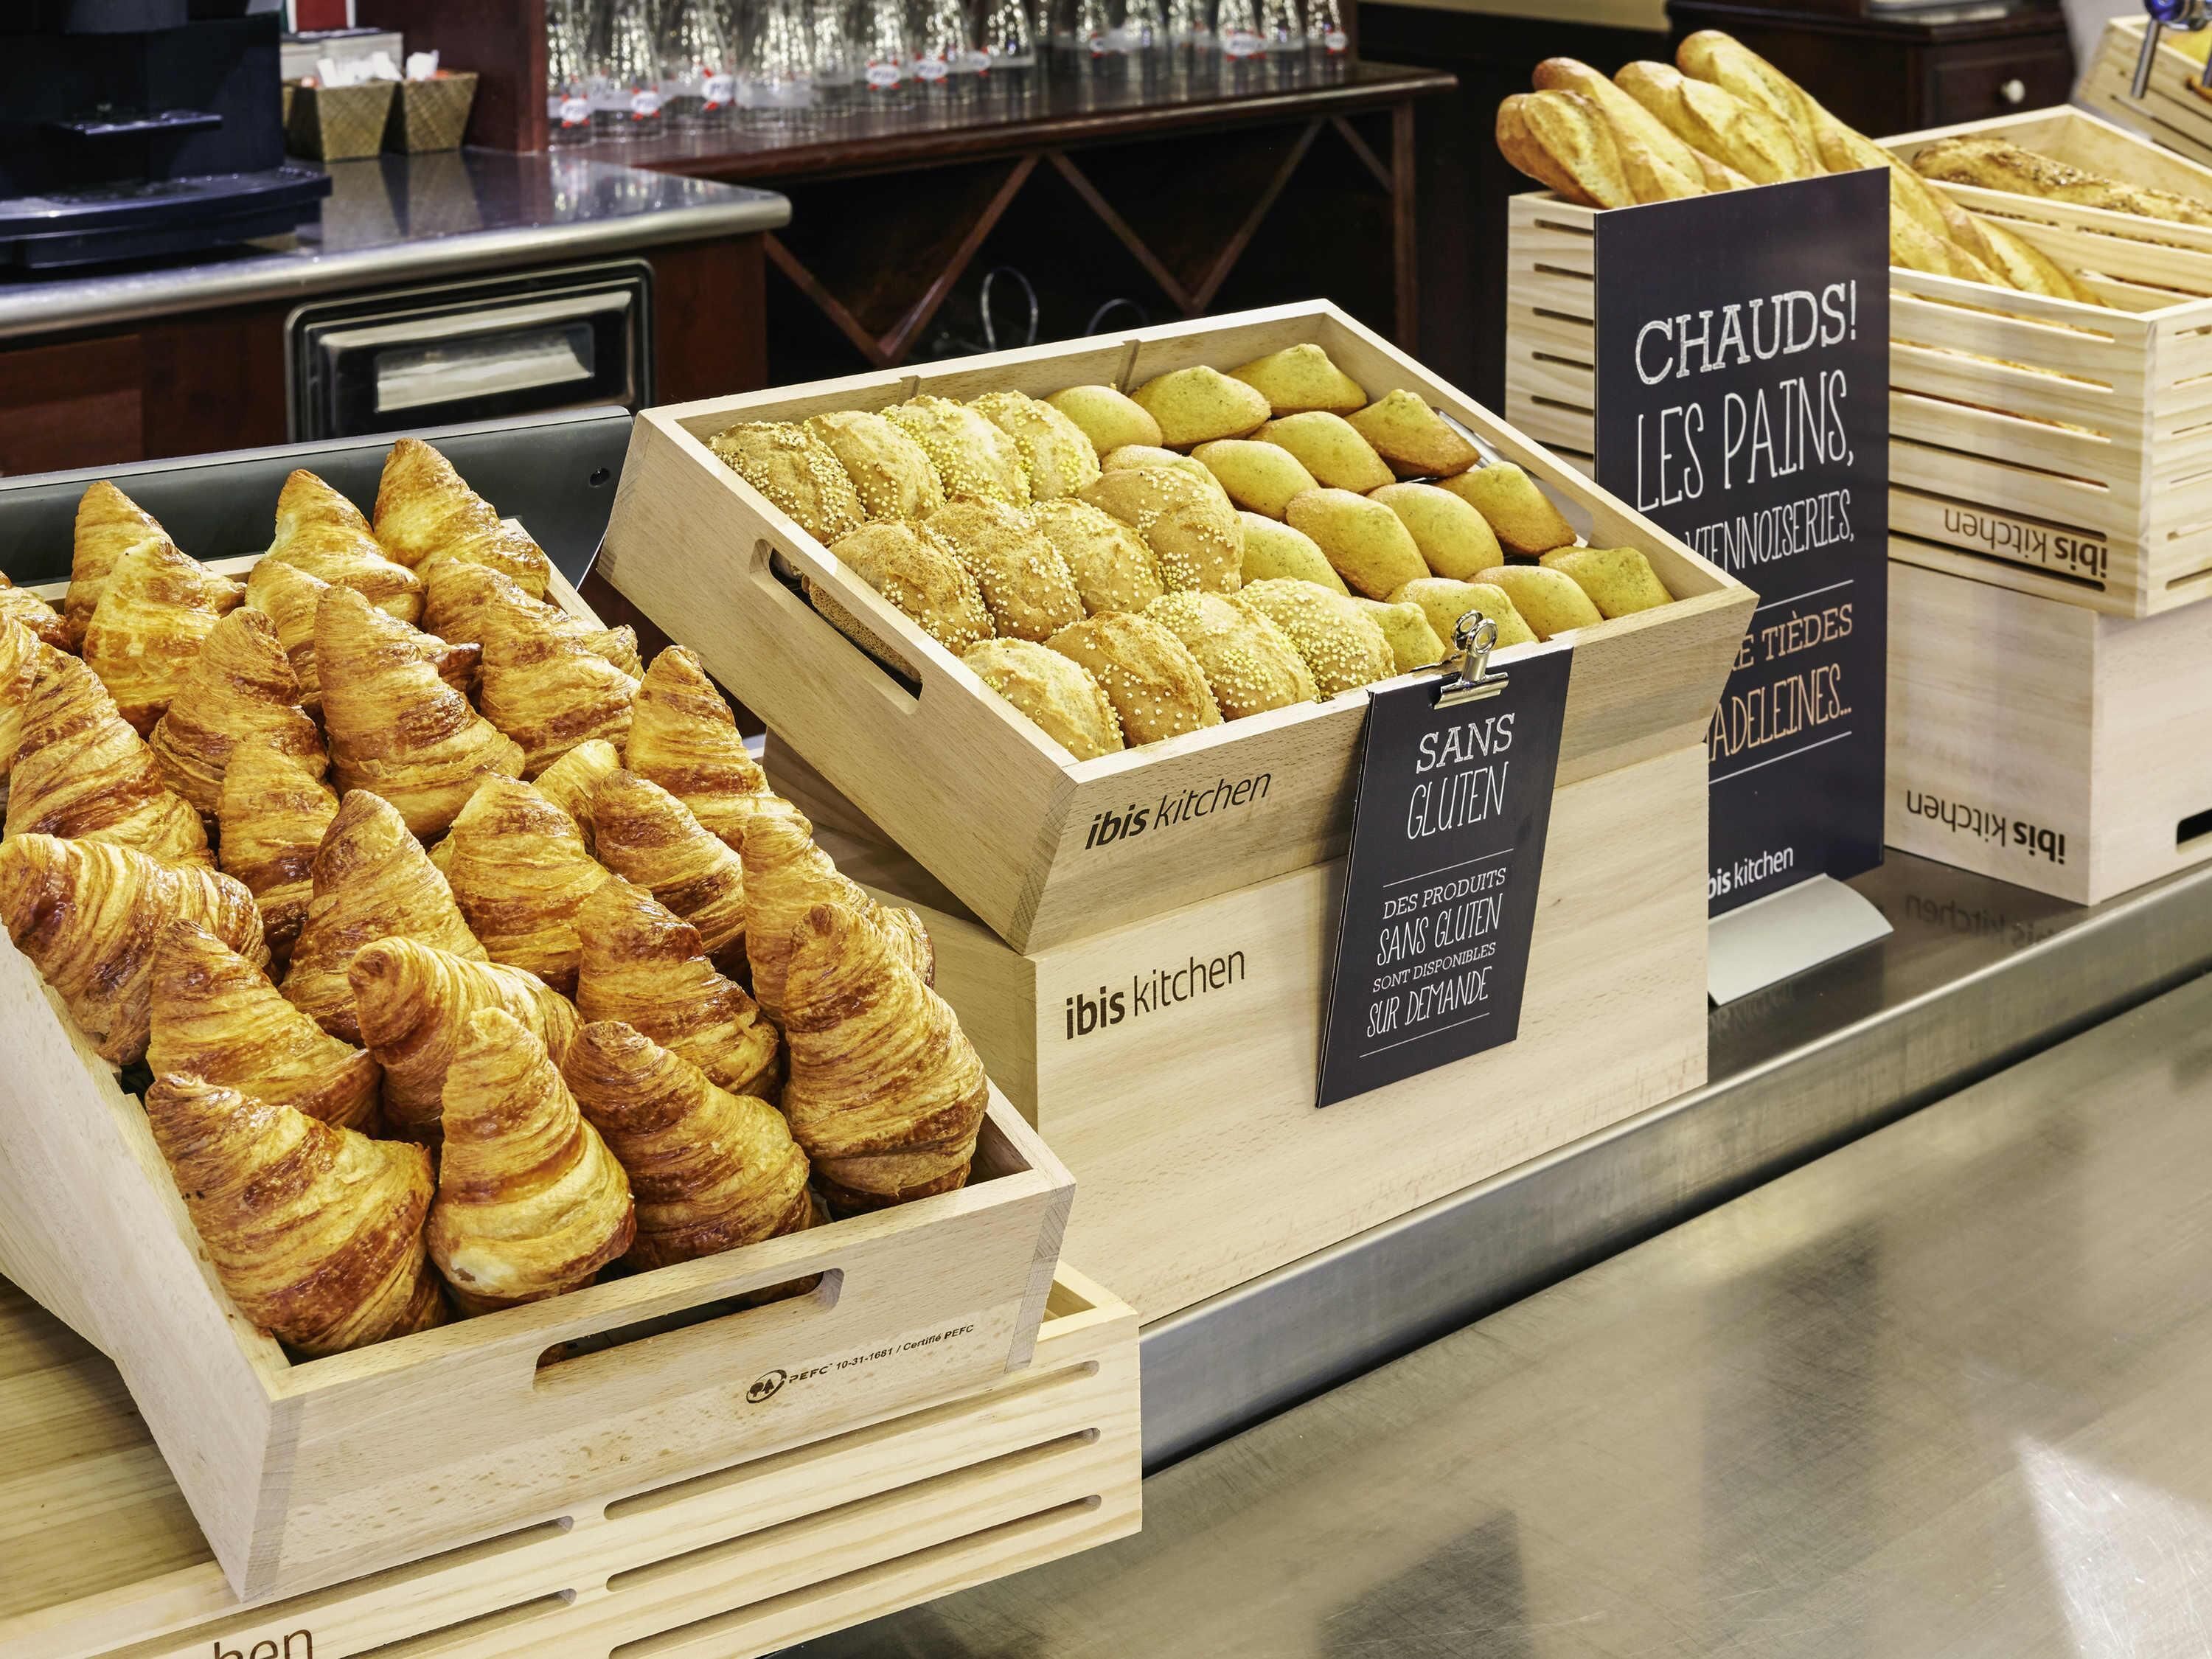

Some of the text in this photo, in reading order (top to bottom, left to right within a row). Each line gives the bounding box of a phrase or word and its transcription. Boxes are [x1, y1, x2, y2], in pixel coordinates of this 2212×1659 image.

[1635, 279, 1857, 385] CHAUDS!
[1637, 369, 1854, 512] LES PAINS,
[1944, 509, 2108, 579] ibis kitchen
[1761, 603, 1853, 661] TIÈDES
[1416, 712, 1515, 774] SANS
[1706, 663, 1852, 762] ADELEINES...
[1085, 773, 1271, 850] ibis kitchen
[1407, 761, 1510, 841] GLUTEN
[1907, 790, 2065, 865] ibis kitchen
[1382, 866, 1506, 920] DES PRODUITS
[1708, 846, 1793, 900] bis kitchen
[1377, 893, 1503, 967] SANS GLUTEN
[1066, 950, 1245, 1040] ibis kitchen
[1366, 965, 1492, 1037] SUR DEMANDE
[1372, 942, 1497, 993] SONT DISPONIBLES
[903, 1333, 942, 1351] Certifié
[944, 1324, 974, 1340] PEFC
